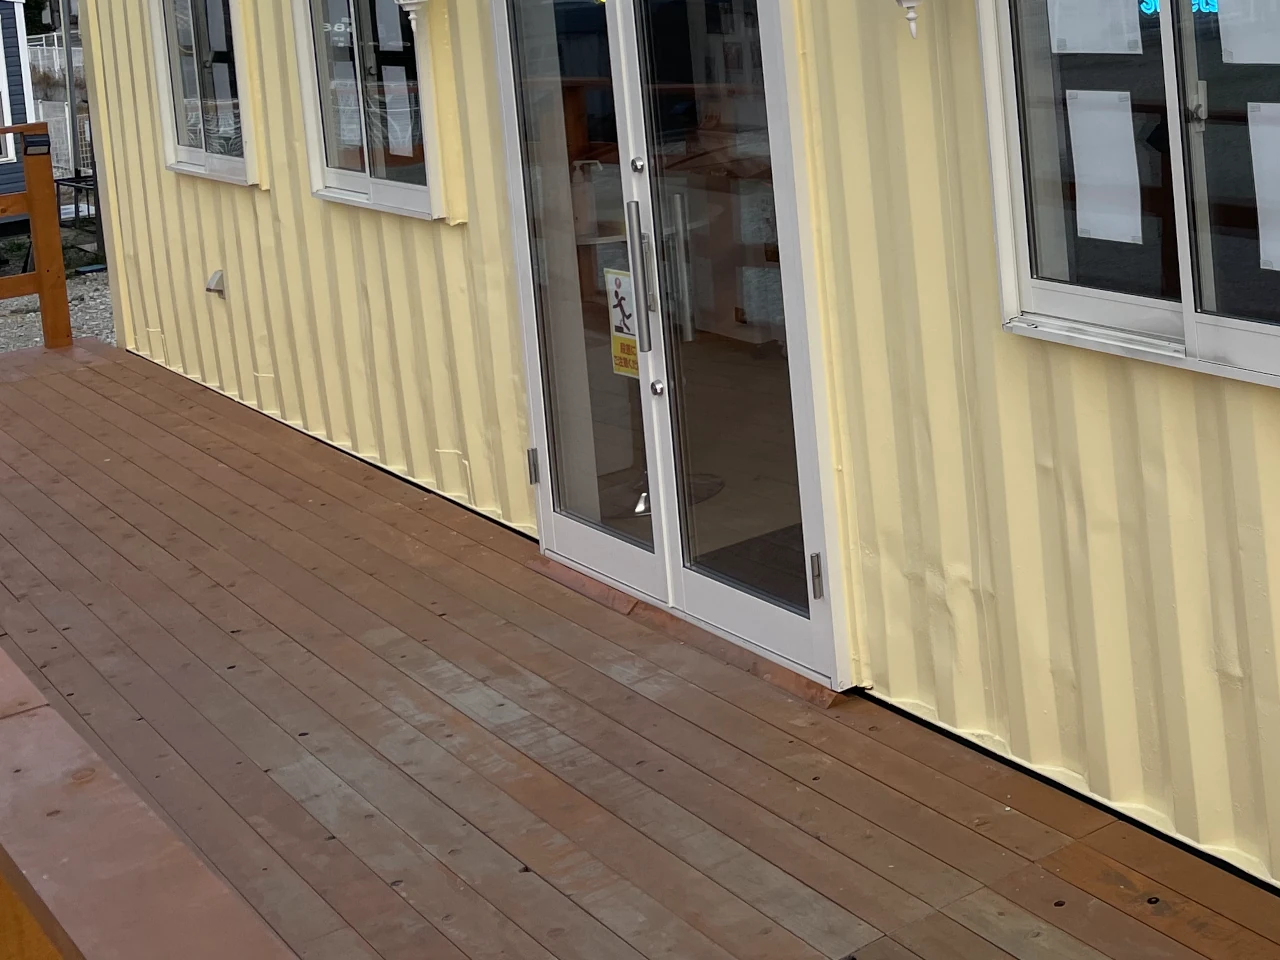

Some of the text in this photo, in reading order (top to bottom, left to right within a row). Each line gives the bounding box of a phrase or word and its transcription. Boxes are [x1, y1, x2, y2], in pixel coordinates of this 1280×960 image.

[614, 356, 638, 370] ご注意くだ
